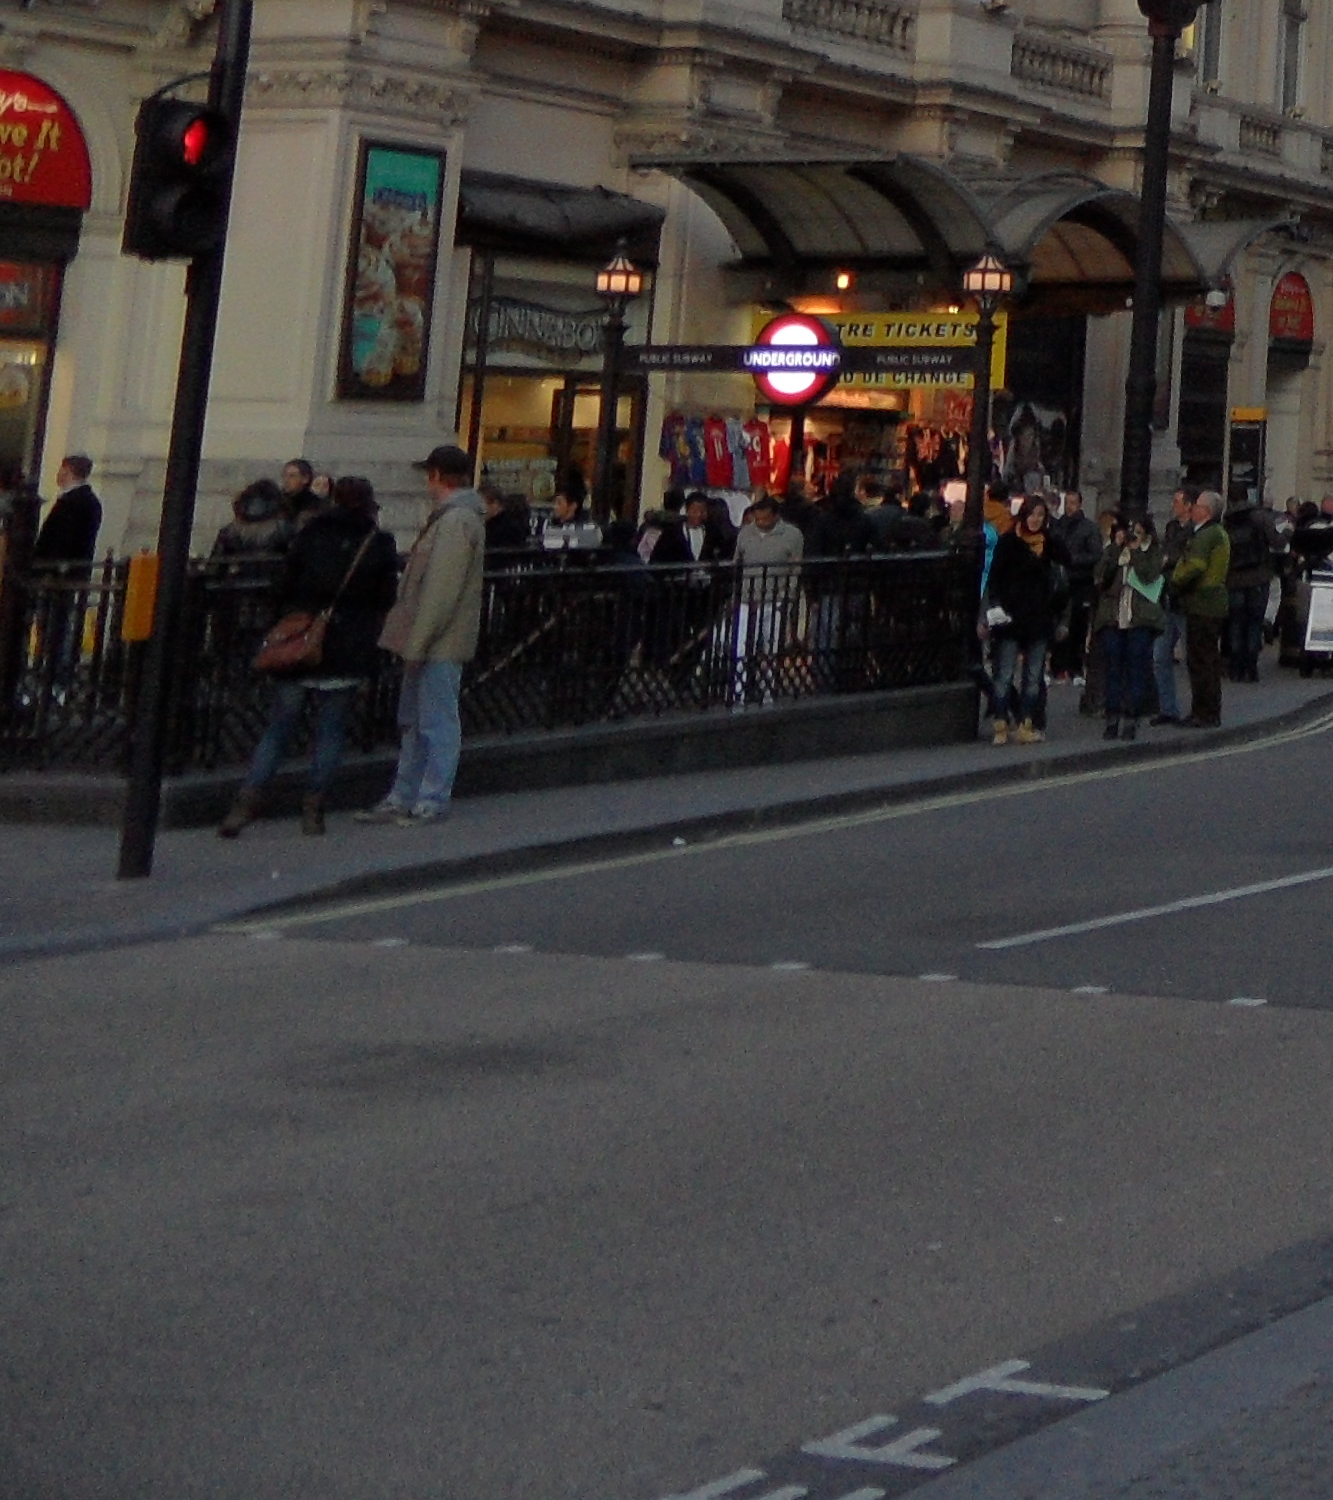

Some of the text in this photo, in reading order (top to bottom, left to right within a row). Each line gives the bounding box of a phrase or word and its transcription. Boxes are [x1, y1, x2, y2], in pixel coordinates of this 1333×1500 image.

[0, 152, 39, 184] ot!
[469, 303, 606, 351] CINNABO
[835, 323, 976, 338] TRE TICKETS
[742, 351, 841, 367] UNDERGROUND
[911, 354, 953, 366] SUBWAY
